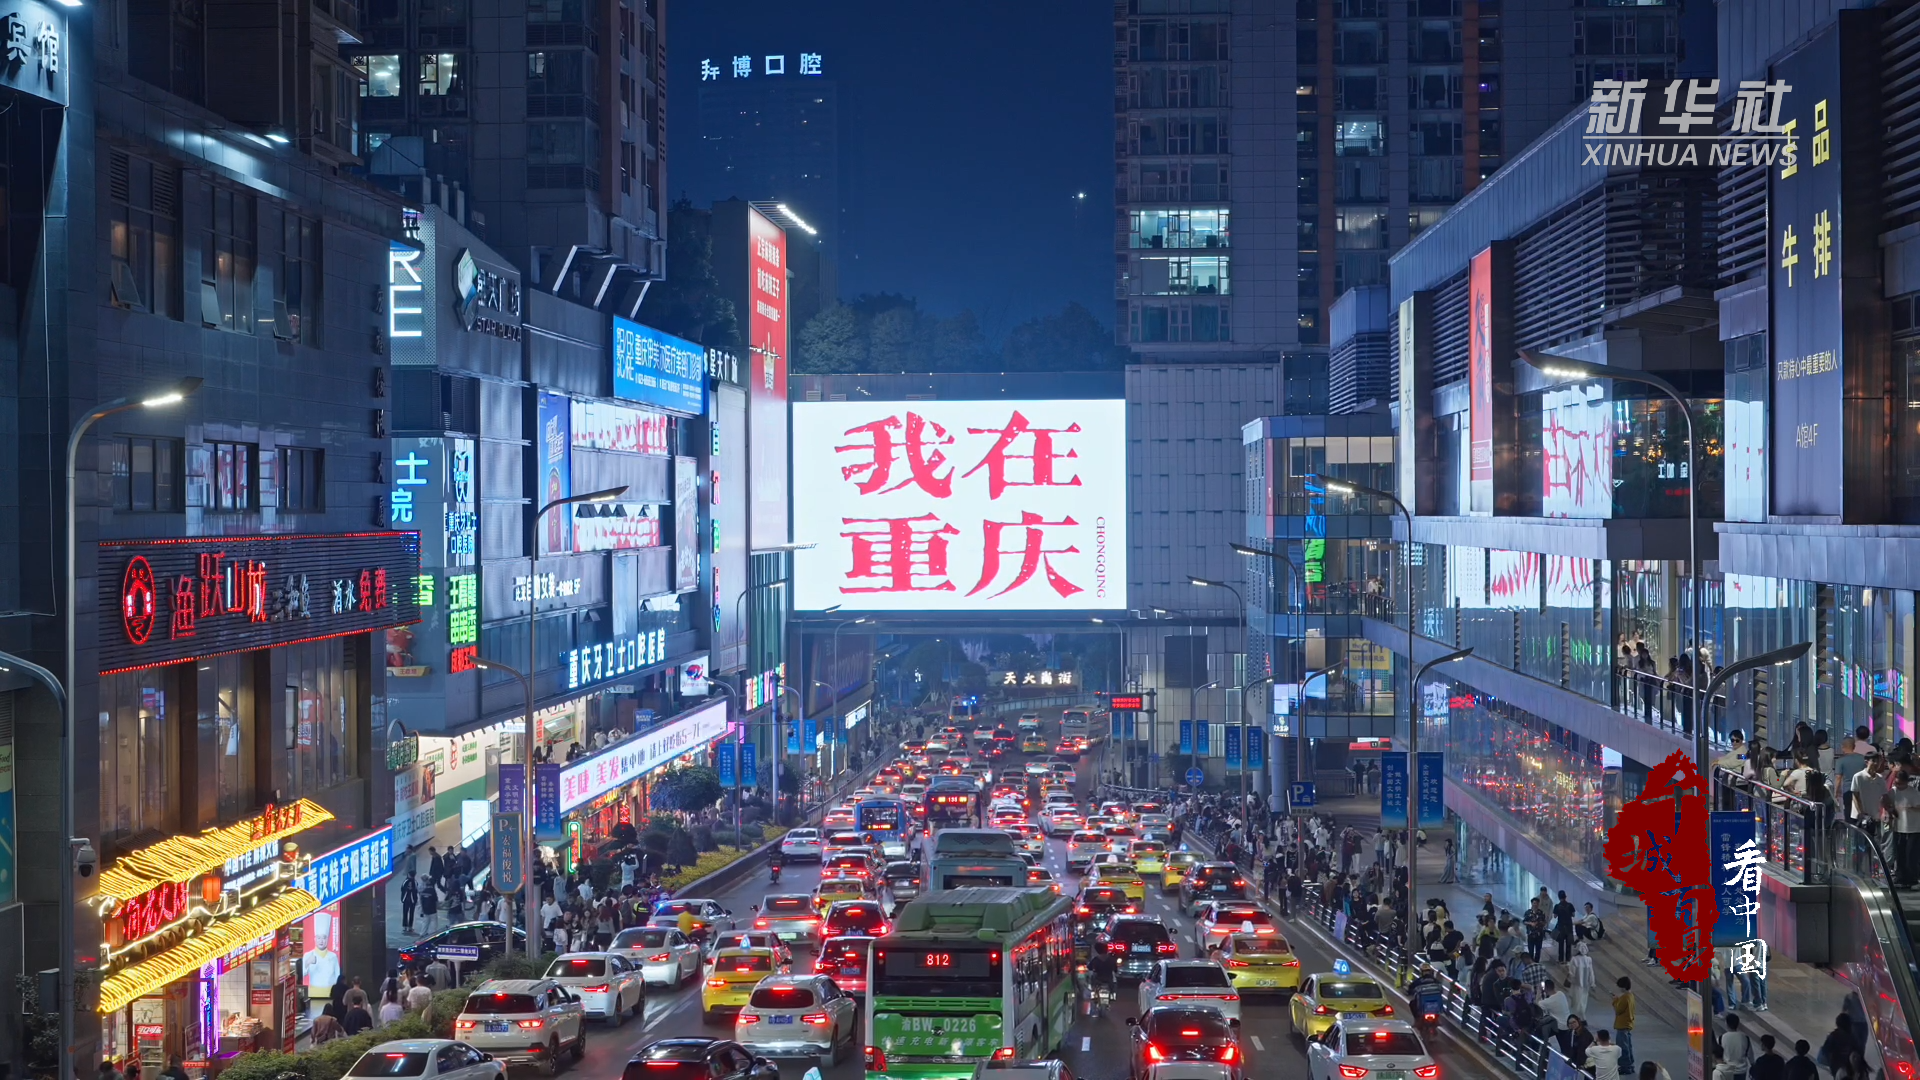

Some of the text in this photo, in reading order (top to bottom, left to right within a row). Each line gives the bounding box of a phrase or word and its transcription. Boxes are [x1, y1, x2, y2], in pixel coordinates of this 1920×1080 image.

[6, 12, 60, 74] 宾馆
[476, 317, 522, 343] STAR PLAZA
[1777, 348, 1838, 381] 只款待心中最重要的人
[834, 410, 1082, 500] 我在
[1796, 422, 1818, 448] A馆4F
[839, 510, 1085, 599] 重庆
[1095, 516, 1106, 599] CHONGQING
[568, 627, 666, 689] 重庆牙卫士口腔医院
[498, 818, 509, 832] P
[502, 834, 512, 883] 宏福俊悦
[926, 953, 949, 966] 812
[943, 1018, 977, 1033] 0226
